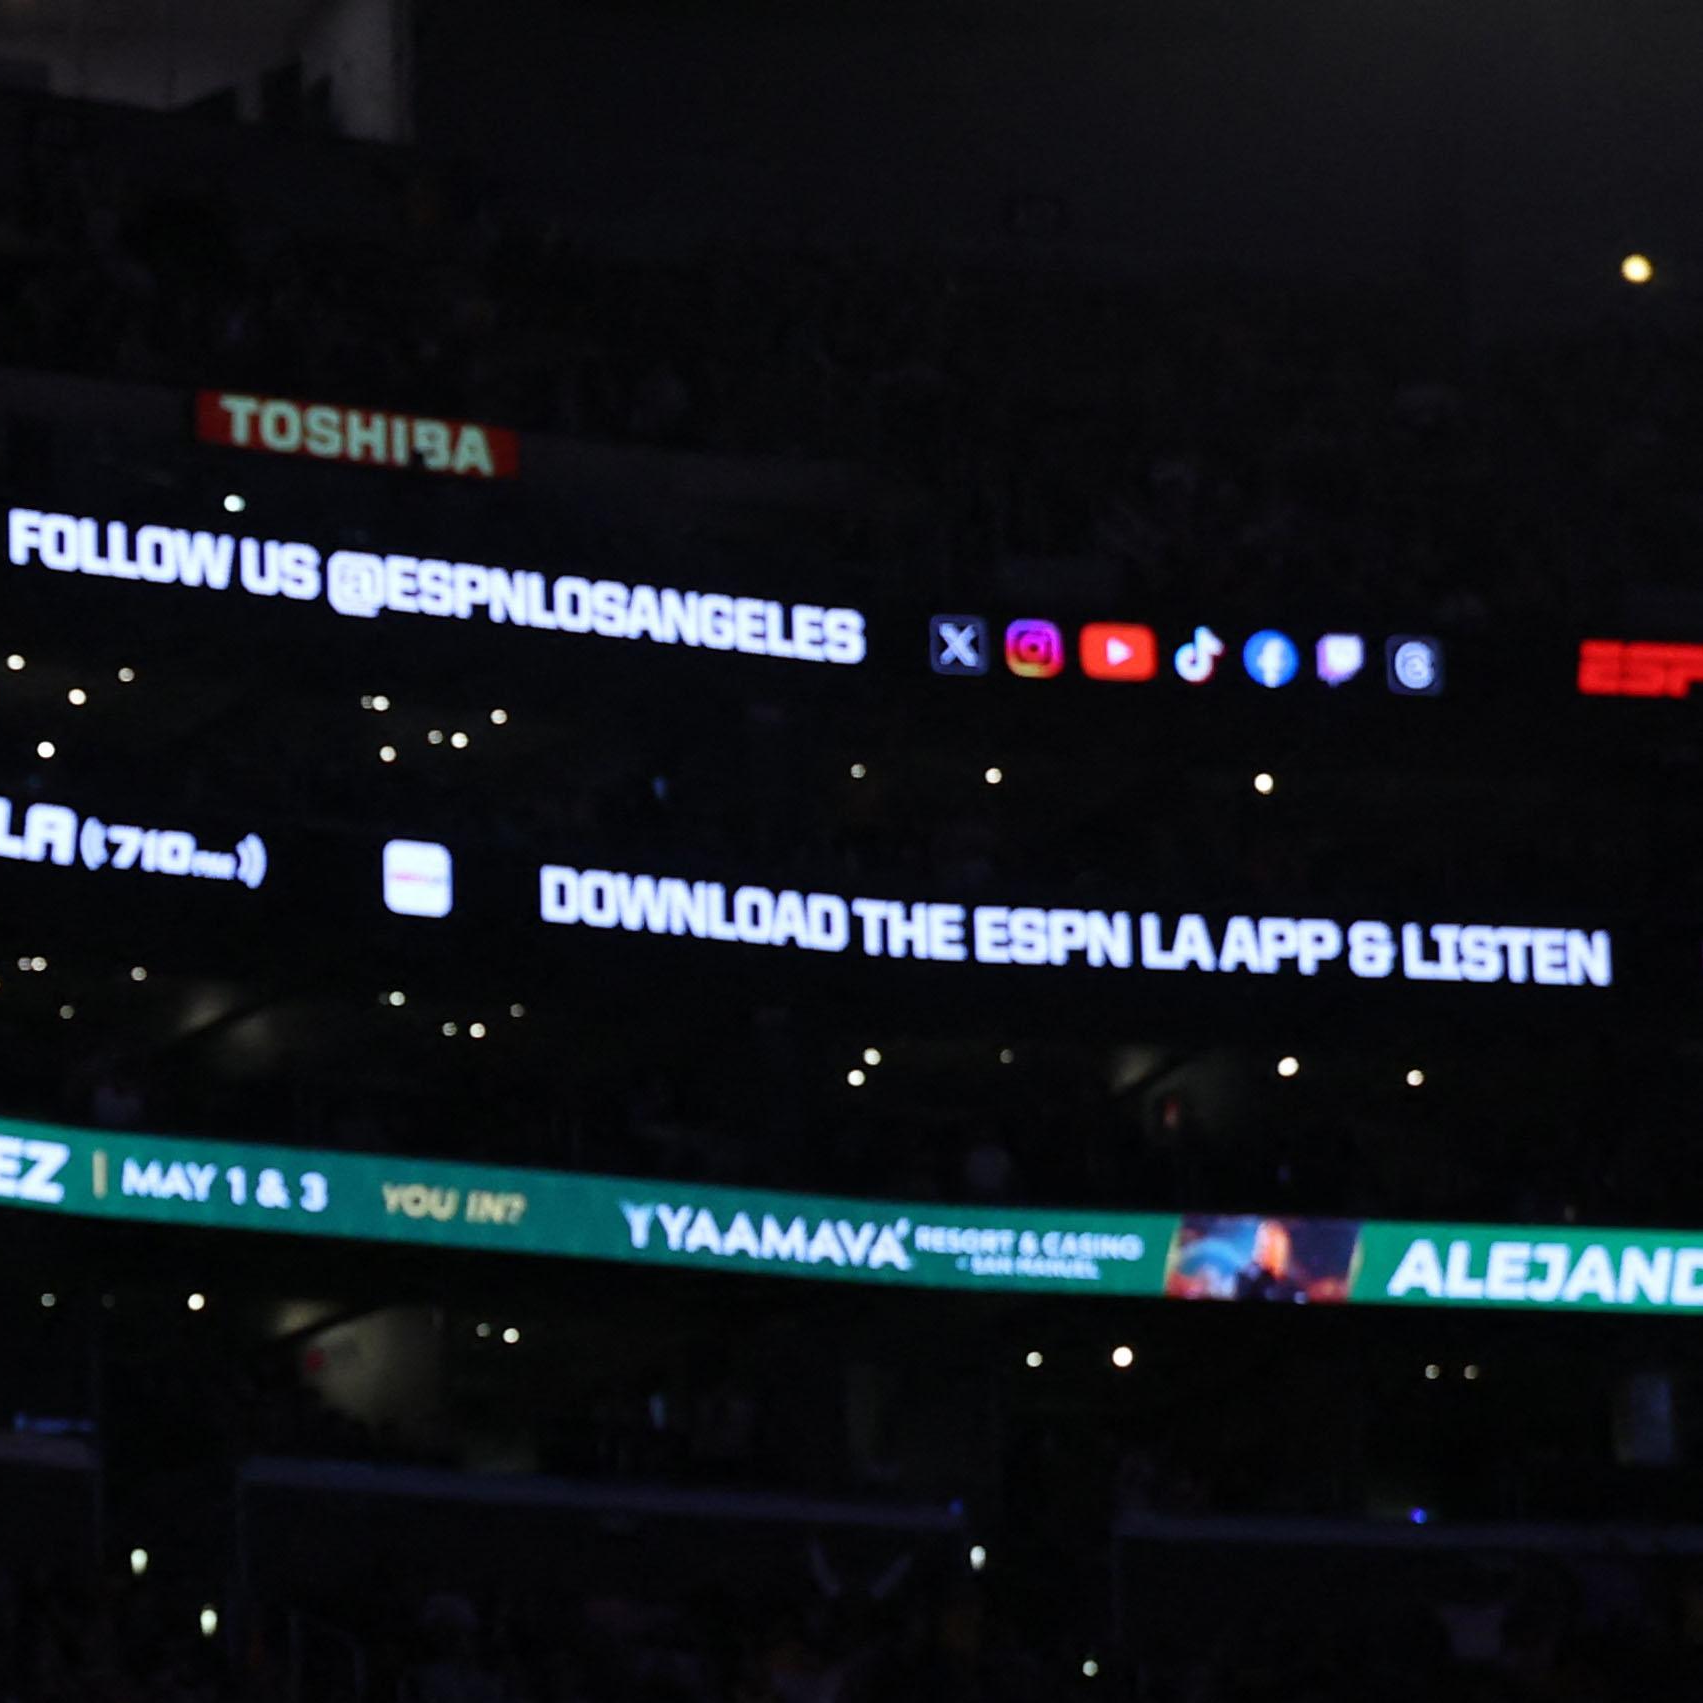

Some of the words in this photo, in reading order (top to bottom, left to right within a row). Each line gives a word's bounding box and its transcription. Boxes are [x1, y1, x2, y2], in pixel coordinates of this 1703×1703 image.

[219, 393, 495, 477] TOSHIBA
[8, 507, 236, 591] FOLLOW
[239, 538, 321, 602] US
[326, 549, 867, 666] @ESPNLOSANGELES
[539, 864, 849, 953] DOWNLOAD
[852, 898, 968, 961] THE
[973, 904, 1132, 970] ESPN
[1140, 911, 1216, 974] LA
[1218, 915, 1342, 977] APP
[1347, 920, 1395, 979] &
[1402, 921, 1613, 987] LISTEN
[121, 1155, 218, 1204] MAY
[224, 1166, 246, 1206] 1
[255, 1168, 292, 1210] &
[299, 1171, 330, 1213] 3
[381, 1181, 458, 1221] YOU
[465, 1188, 527, 1226] IN?
[914, 1225, 1017, 1255] RESORT
[1041, 1231, 1144, 1262] CASINO
